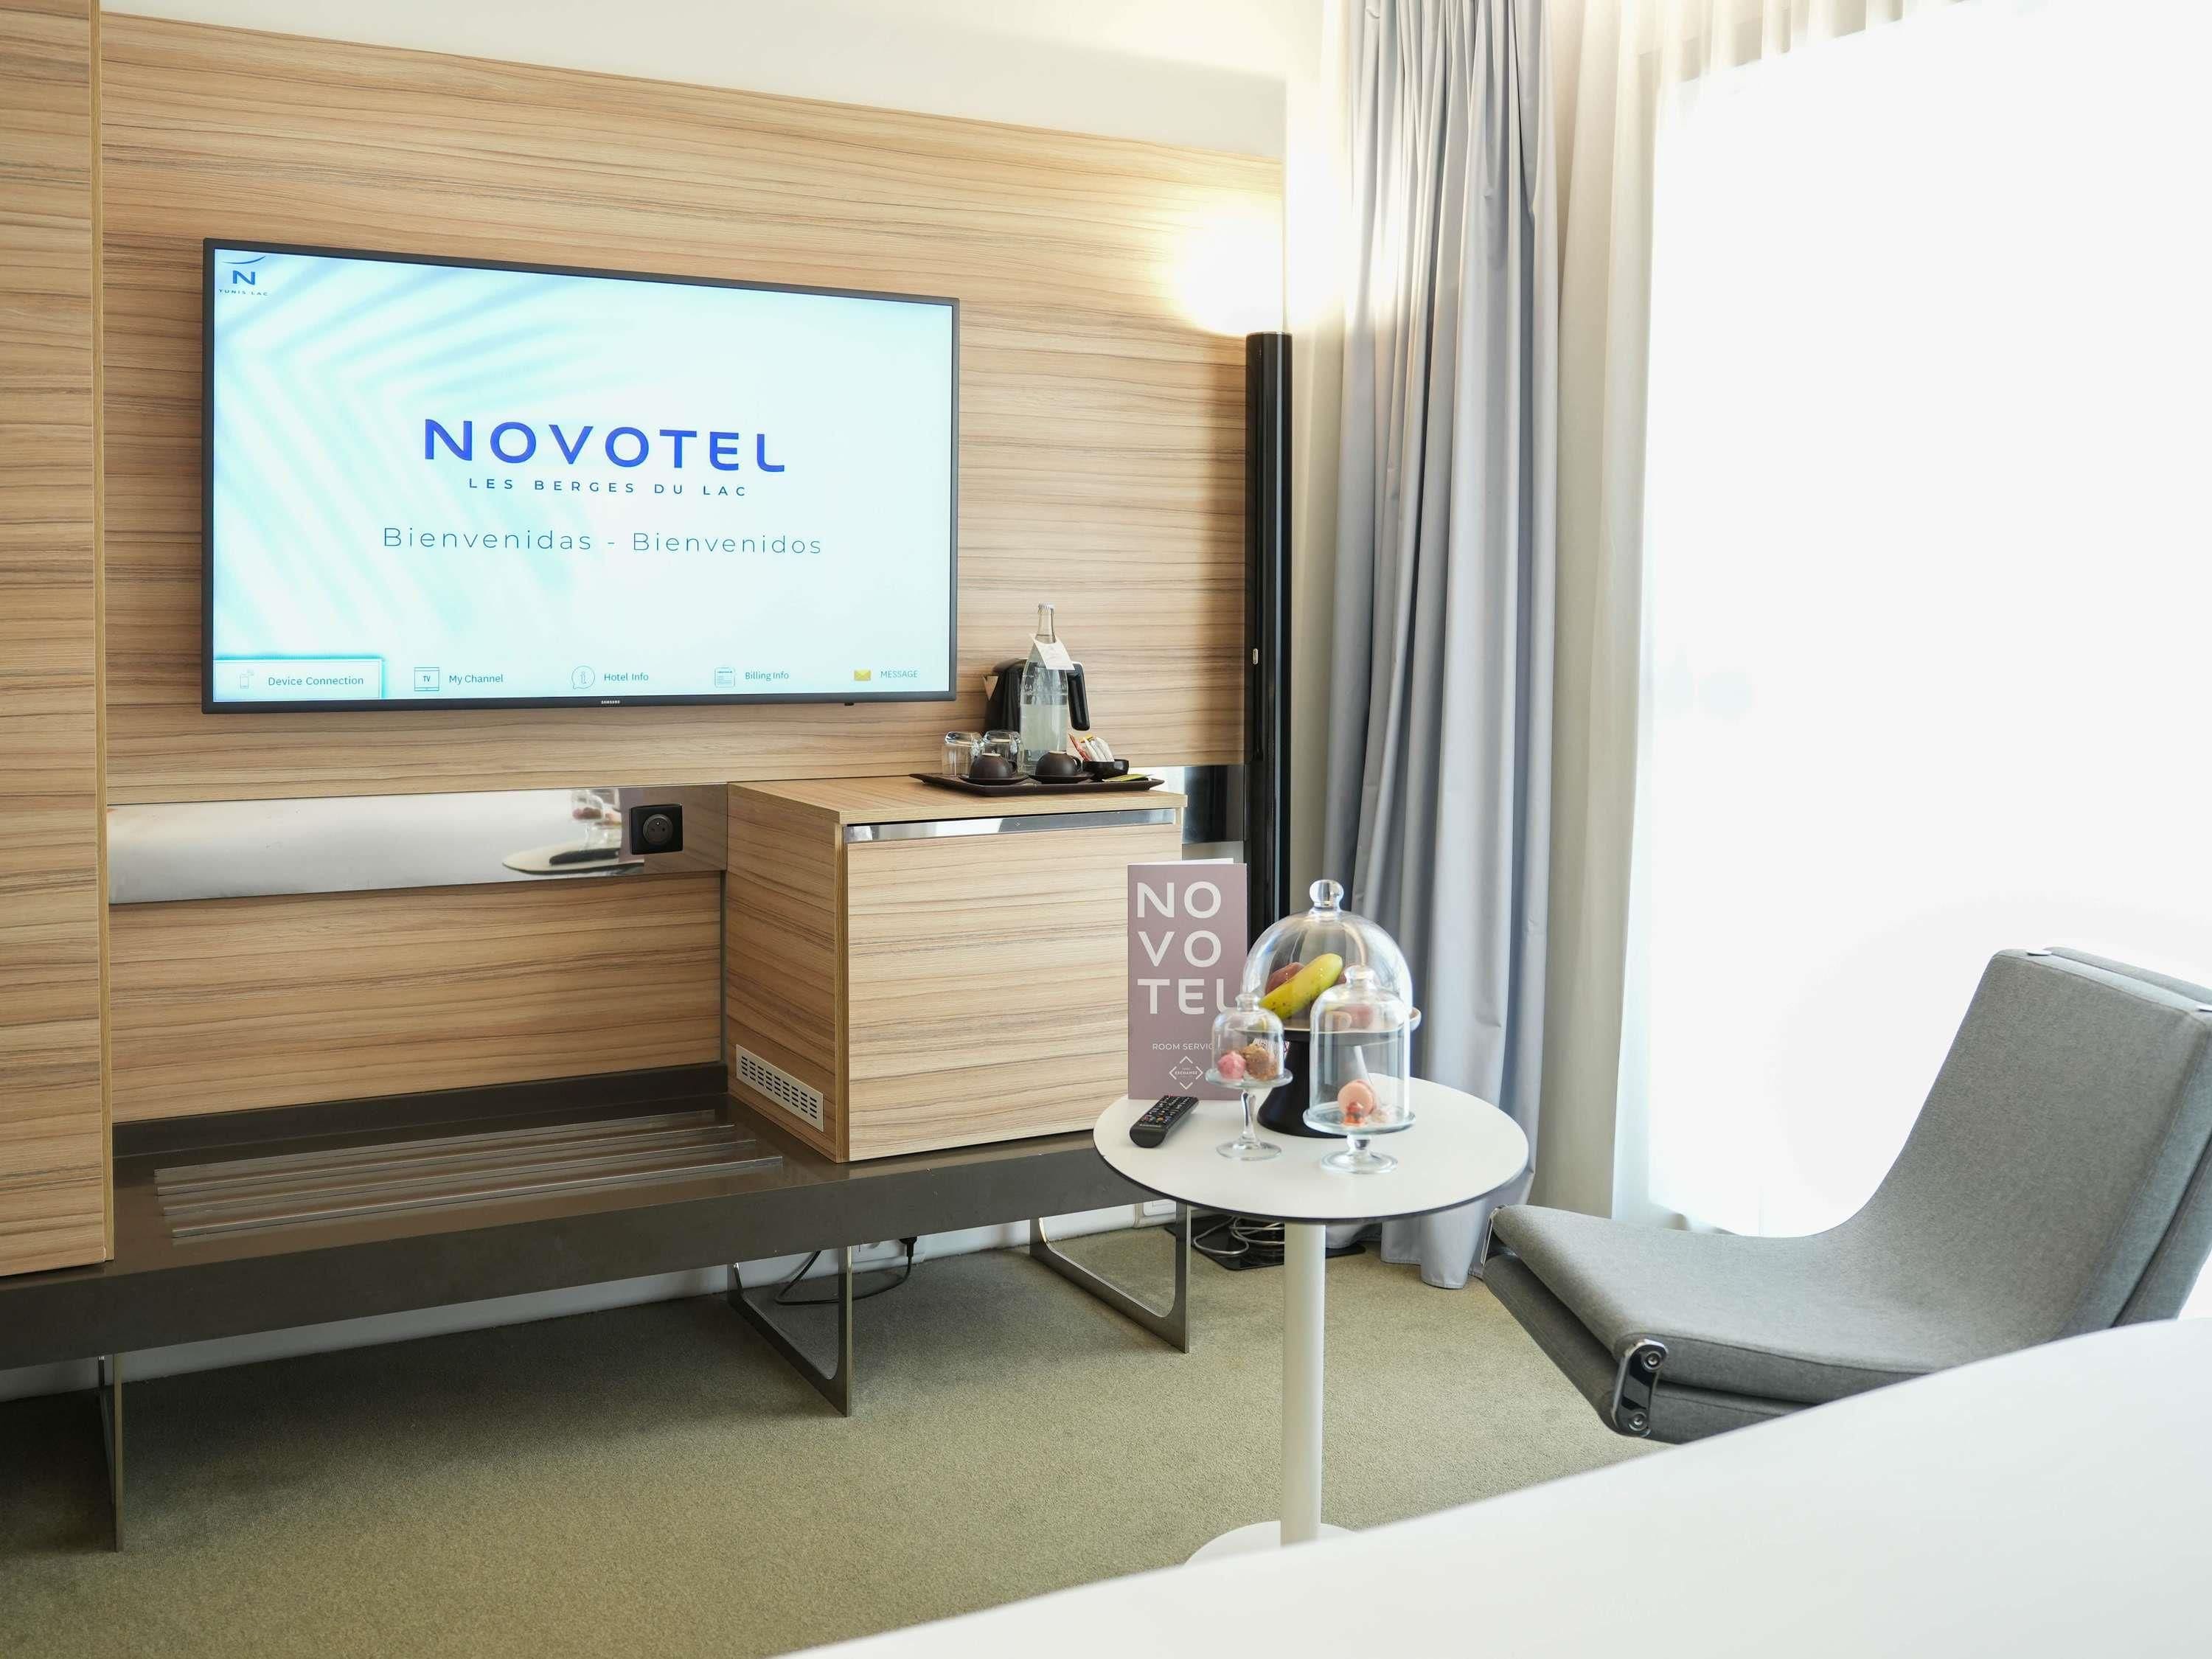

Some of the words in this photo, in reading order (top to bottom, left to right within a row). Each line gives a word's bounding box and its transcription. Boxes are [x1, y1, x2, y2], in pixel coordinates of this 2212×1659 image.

[232, 270, 255, 285] N
[425, 419, 785, 473] NOVOTEL
[469, 478, 513, 490] LES
[535, 480, 633, 493] BERGES
[654, 484, 683, 495] DU
[703, 485, 745, 496] LAC
[383, 526, 591, 549] Bienvenidas
[633, 532, 821, 554] Bienvenidos
[268, 677, 302, 686] Device
[306, 675, 364, 686] Connection
[449, 675, 462, 685] My
[465, 674, 504, 683] Channel
[604, 672, 627, 681] Hotel
[632, 672, 649, 681] Info
[745, 671, 771, 681] Billing
[773, 671, 790, 679] Info
[880, 670, 918, 678] MESSAGE
[1136, 881, 1222, 919] NO
[1138, 930, 1222, 968] VO
[1137, 978, 1236, 1015] TEL
